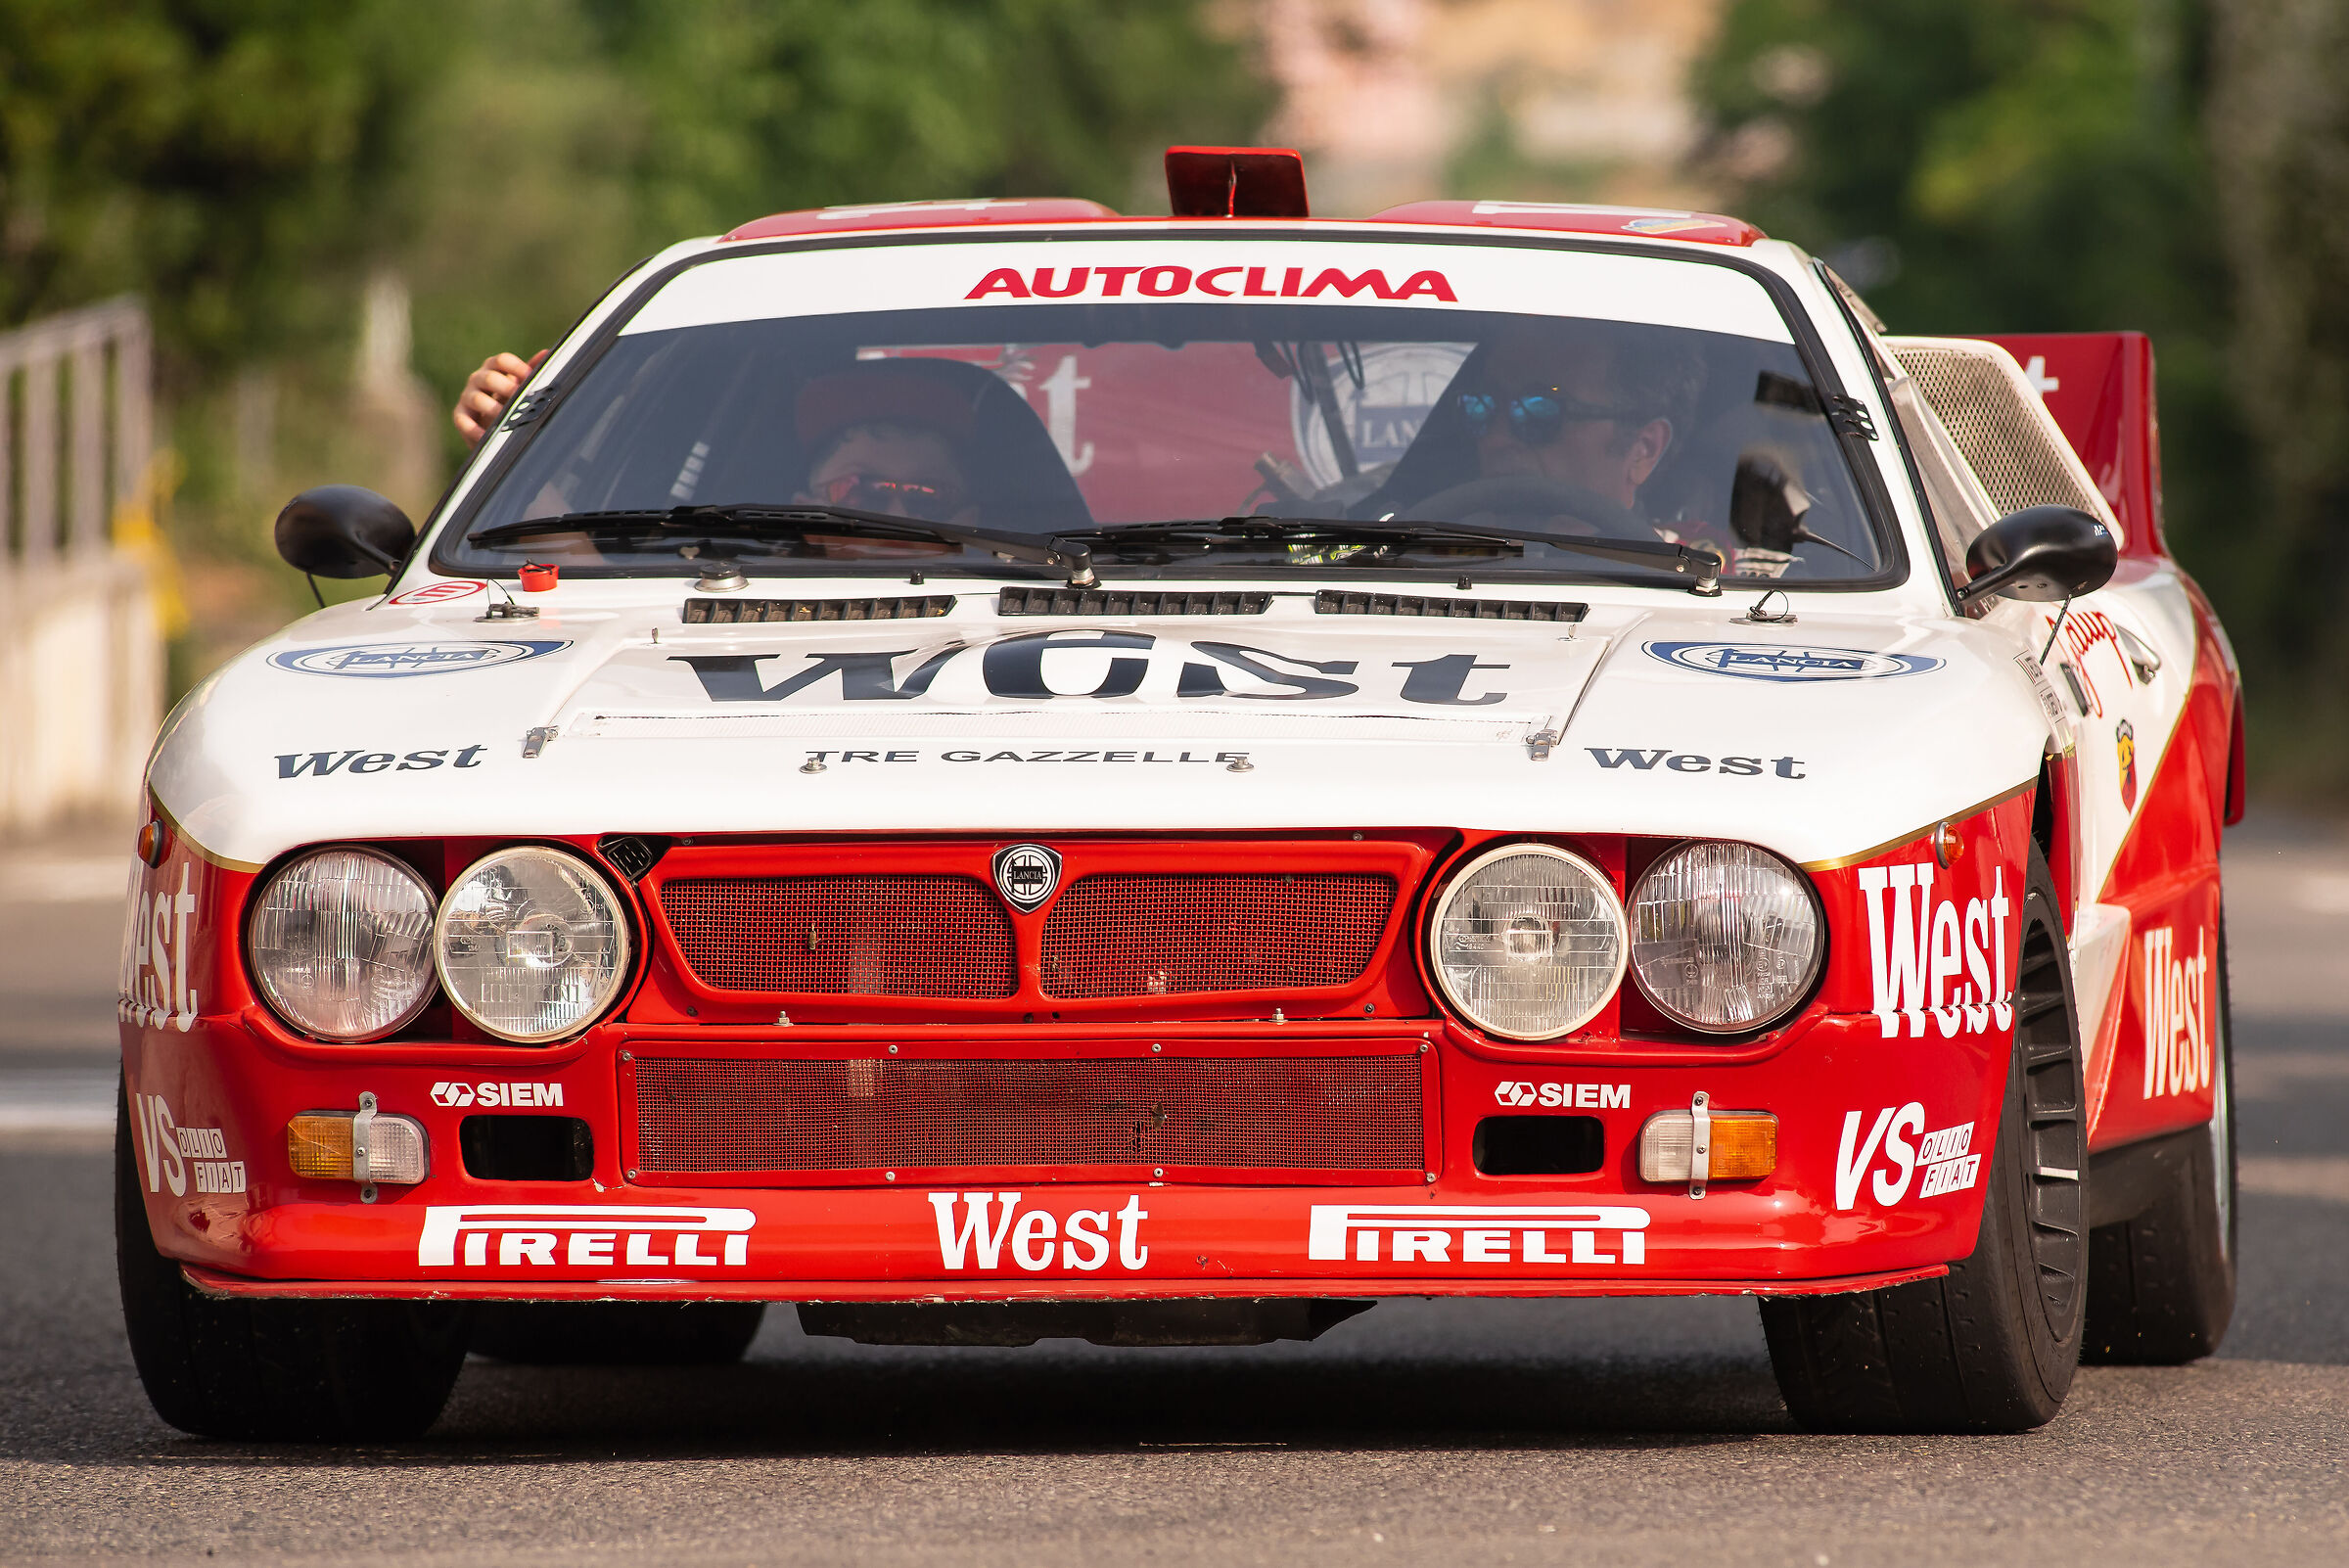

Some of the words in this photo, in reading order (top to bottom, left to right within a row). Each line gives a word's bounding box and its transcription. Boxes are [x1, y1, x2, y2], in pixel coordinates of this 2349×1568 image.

[964, 265, 1458, 302] AUTOCLIMA
[352, 651, 475, 665] LANCIA
[1727, 653, 1852, 669] LANCIA
[273, 744, 488, 779] West
[805, 750, 919, 763] TRE
[941, 750, 1250, 763] GAZZELLE
[1584, 747, 1807, 780] West
[1013, 870, 1042, 880] LANCIA
[1858, 861, 2013, 1039] West
[2143, 925, 2210, 1100] West
[477, 1082, 564, 1107] SIEM
[1538, 1083, 1632, 1109] SIEM
[135, 1092, 187, 1198] VS
[178, 1130, 224, 1155] OLIO
[1835, 1101, 1926, 1211] VS
[1920, 1126, 1971, 1163] OLIO
[196, 1164, 244, 1190] FIAT
[1923, 1158, 1978, 1194] FIAT
[418, 1205, 757, 1267] PIRELLI
[927, 1191, 1149, 1271] West
[1308, 1204, 1651, 1265] PIRELLI
